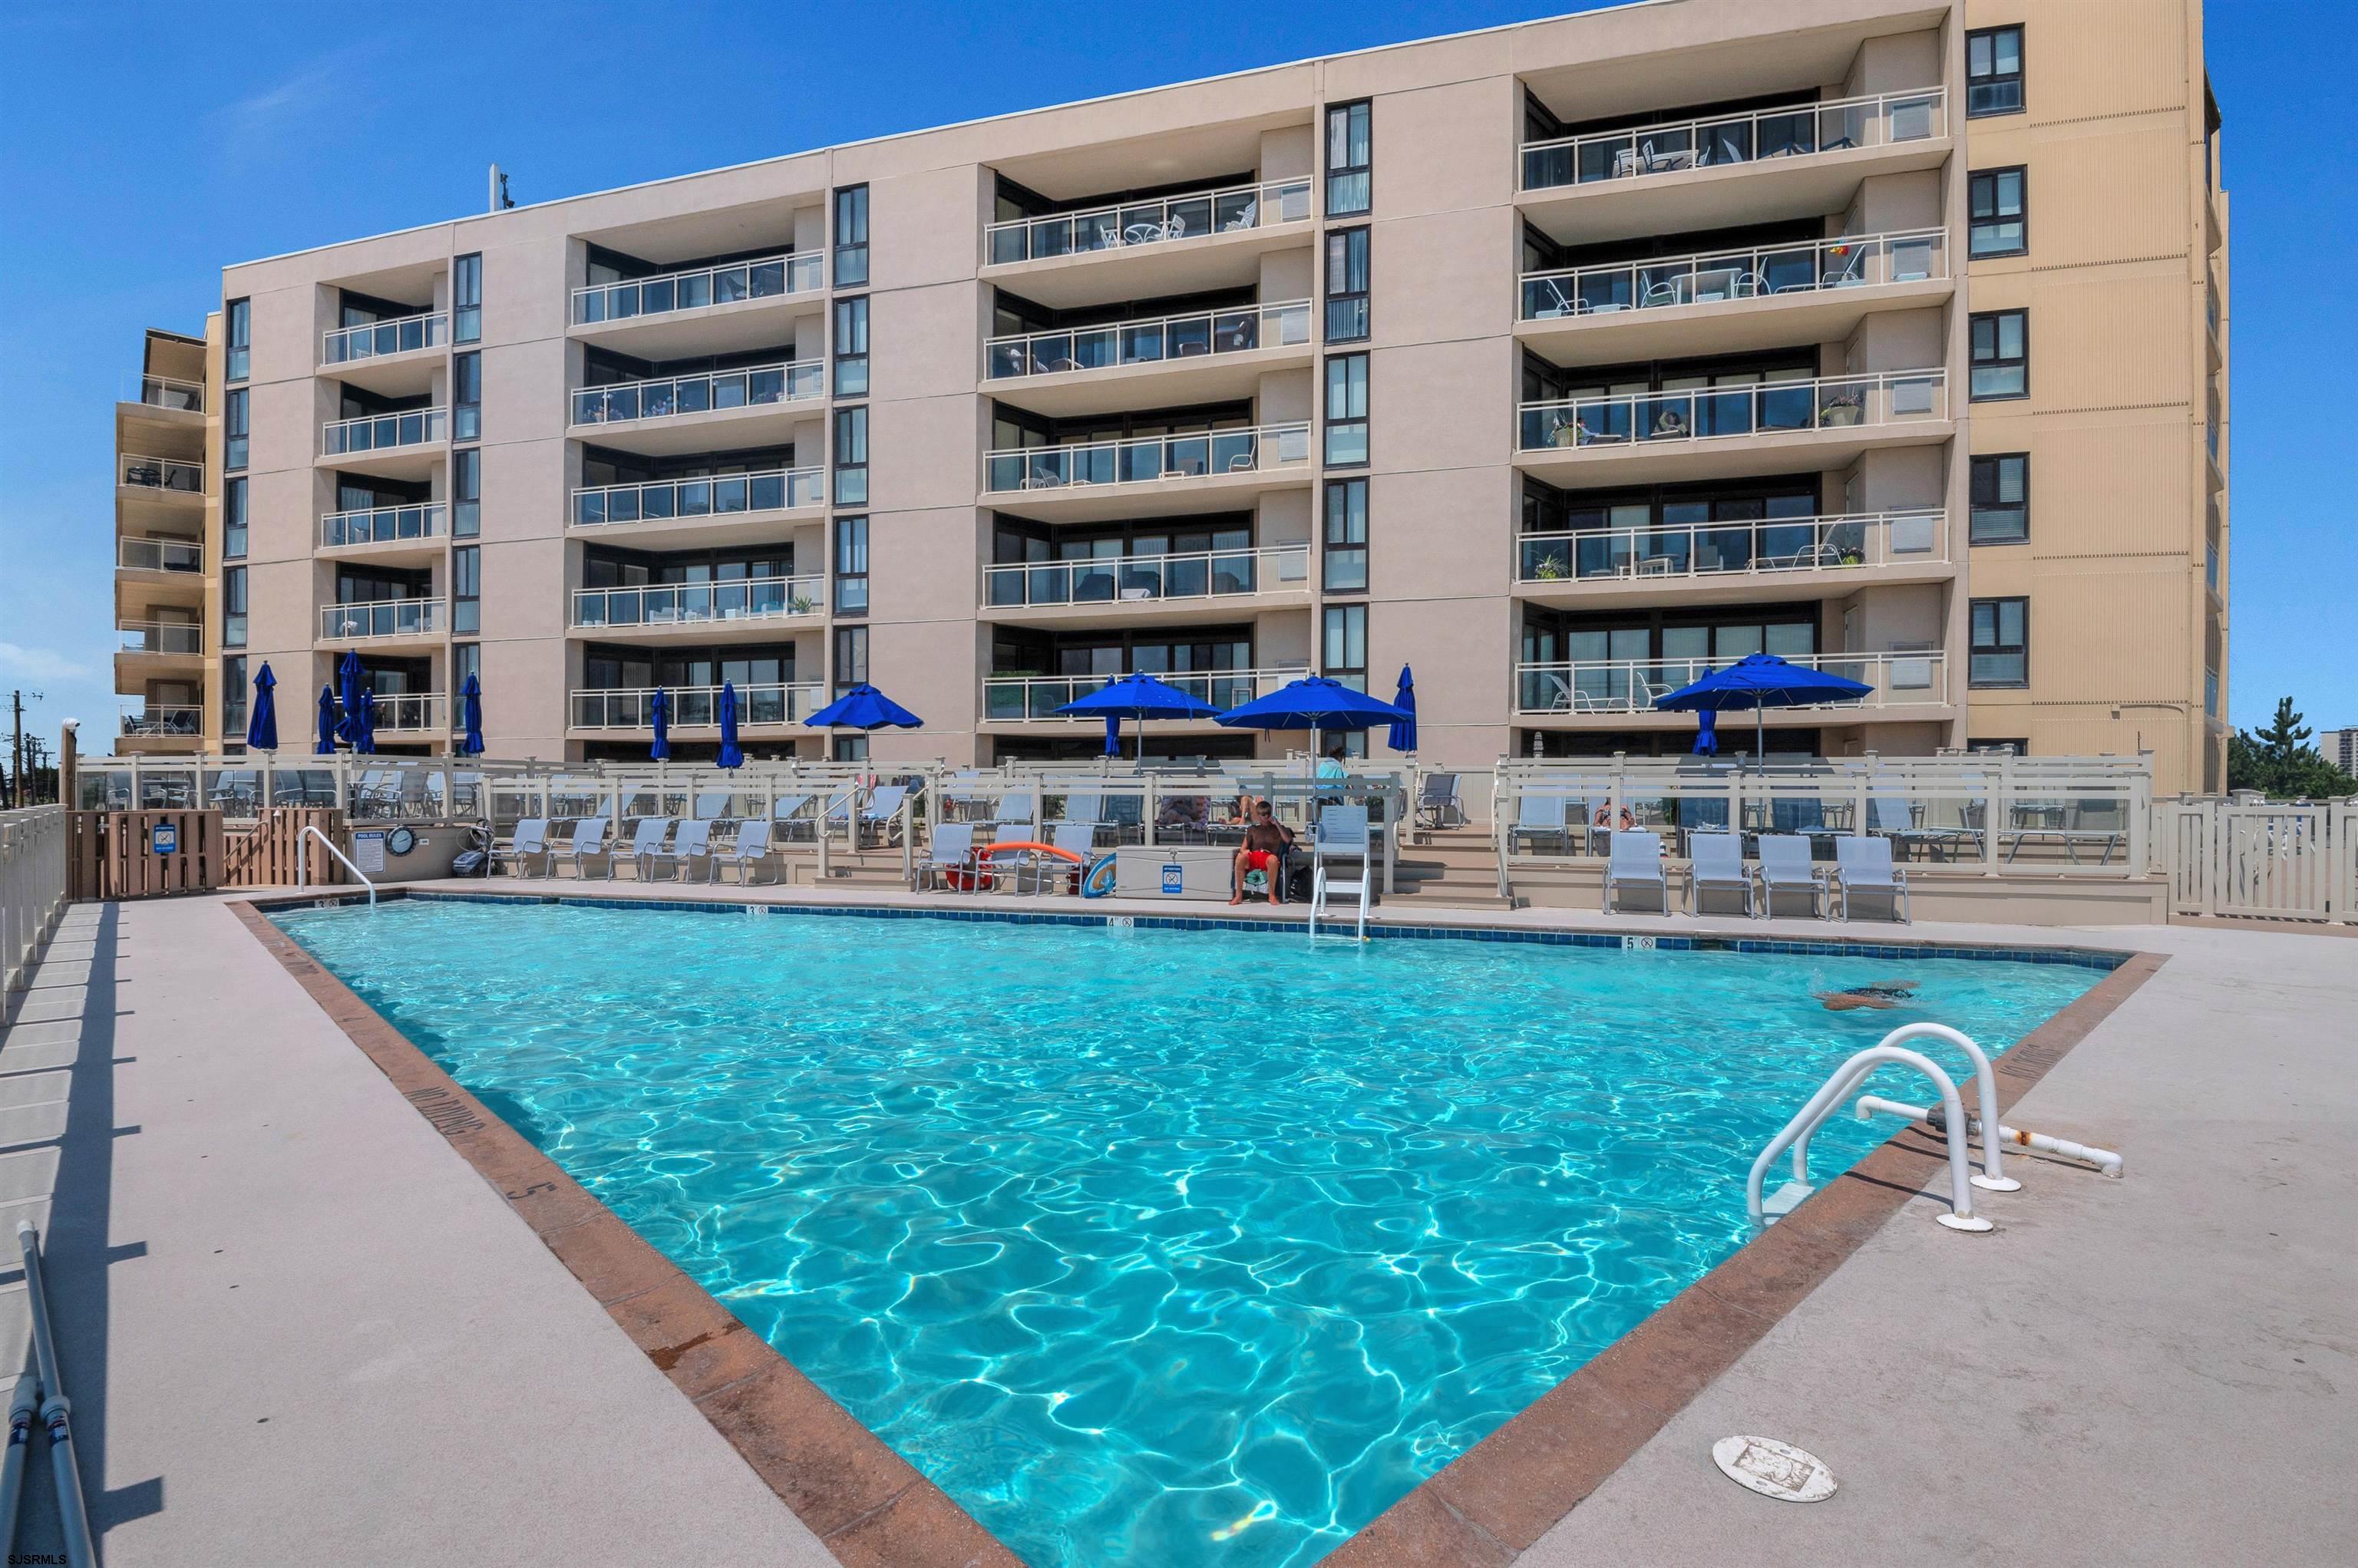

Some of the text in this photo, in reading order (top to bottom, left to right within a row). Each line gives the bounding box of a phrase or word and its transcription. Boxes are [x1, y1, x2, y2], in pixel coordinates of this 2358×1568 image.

[1626, 936, 1633, 949] 5
[402, 1086, 487, 1136] NO DIVING
[506, 1181, 558, 1200] 5
